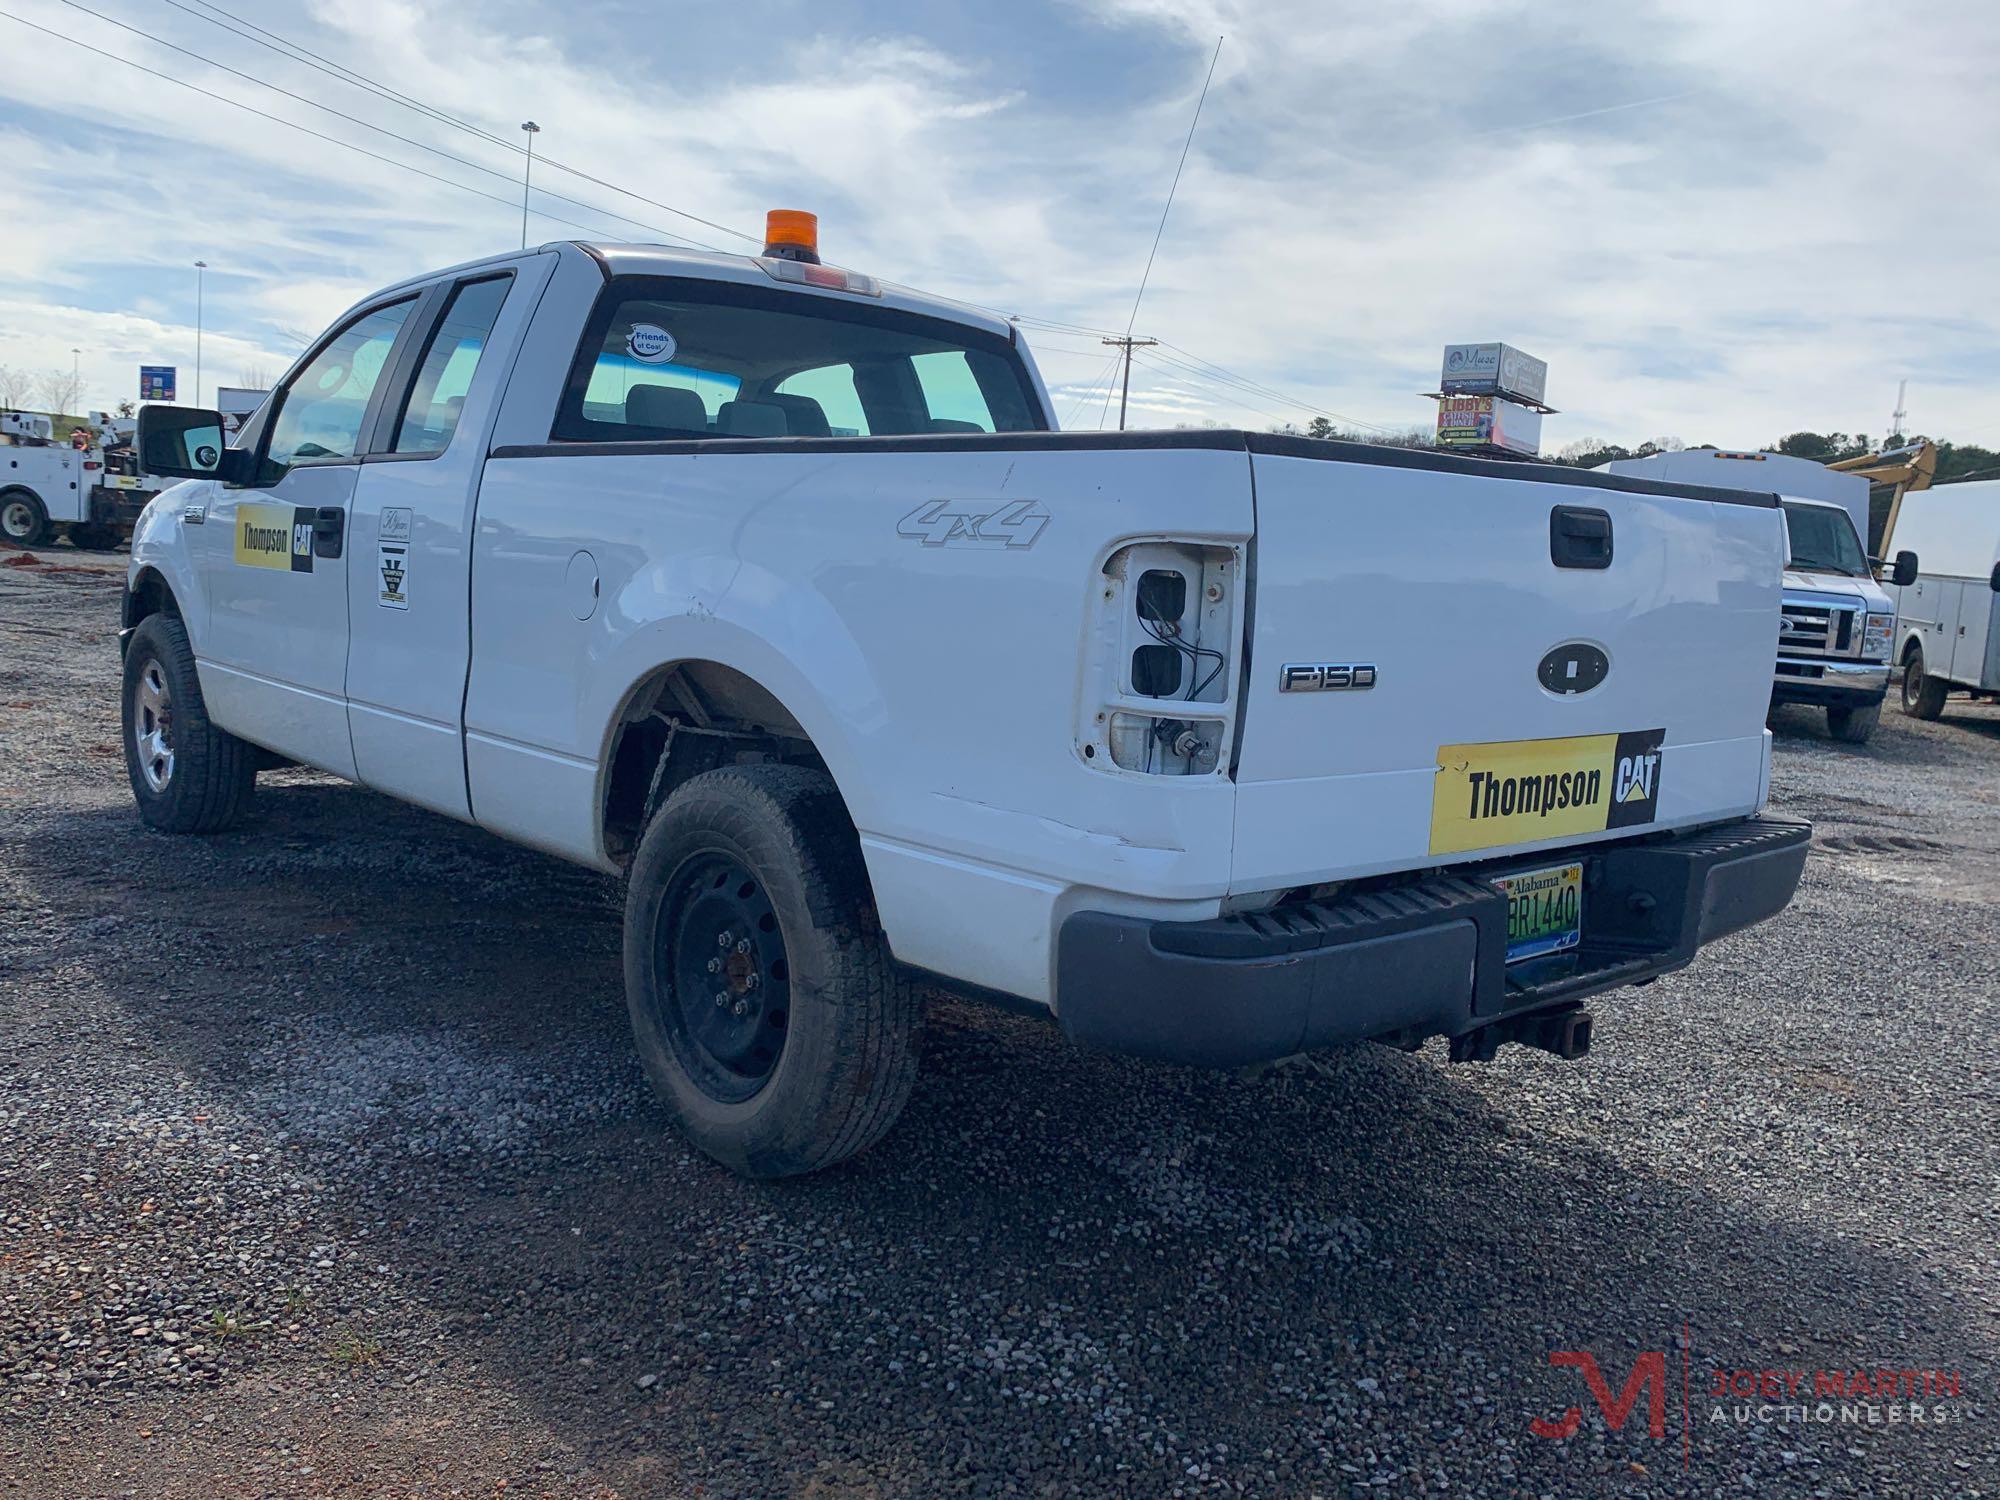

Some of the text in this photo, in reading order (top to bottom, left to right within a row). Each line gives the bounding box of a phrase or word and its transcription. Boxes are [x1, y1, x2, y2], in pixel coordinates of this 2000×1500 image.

[636, 332, 669, 341] Friends
[1444, 398, 1492, 412] LIBBY'S
[244, 522, 287, 555] Thompson
[293, 524, 313, 556] CAT
[1286, 665, 1376, 690] F-150
[1469, 768, 1601, 819] Thompson
[1615, 755, 1657, 804] CAT
[1513, 876, 1559, 895] Alabama
